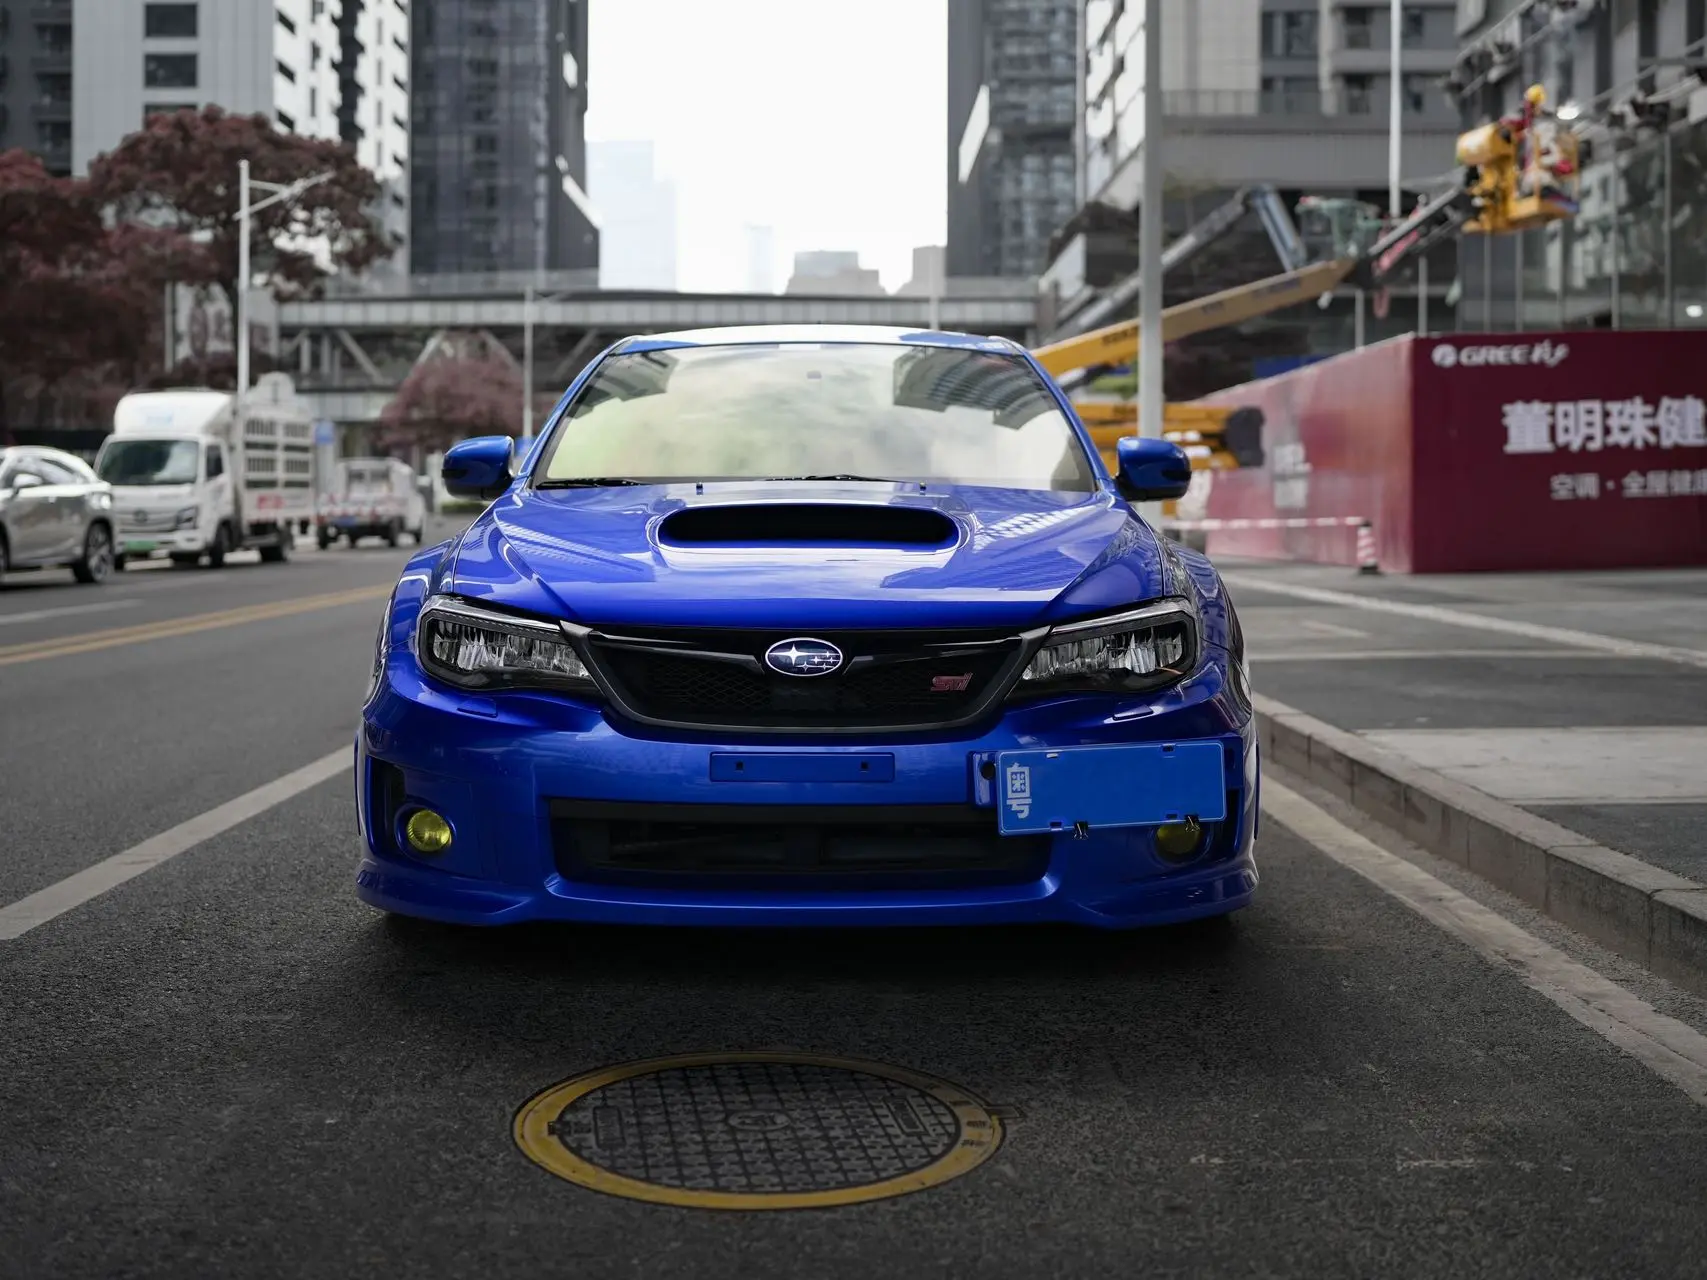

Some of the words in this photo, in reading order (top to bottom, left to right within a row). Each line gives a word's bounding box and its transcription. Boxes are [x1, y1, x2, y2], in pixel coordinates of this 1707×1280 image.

[1459, 345, 1531, 366] GREE
[1502, 396, 1707, 453] 董明珠健
[1006, 762, 1032, 819] 粤
